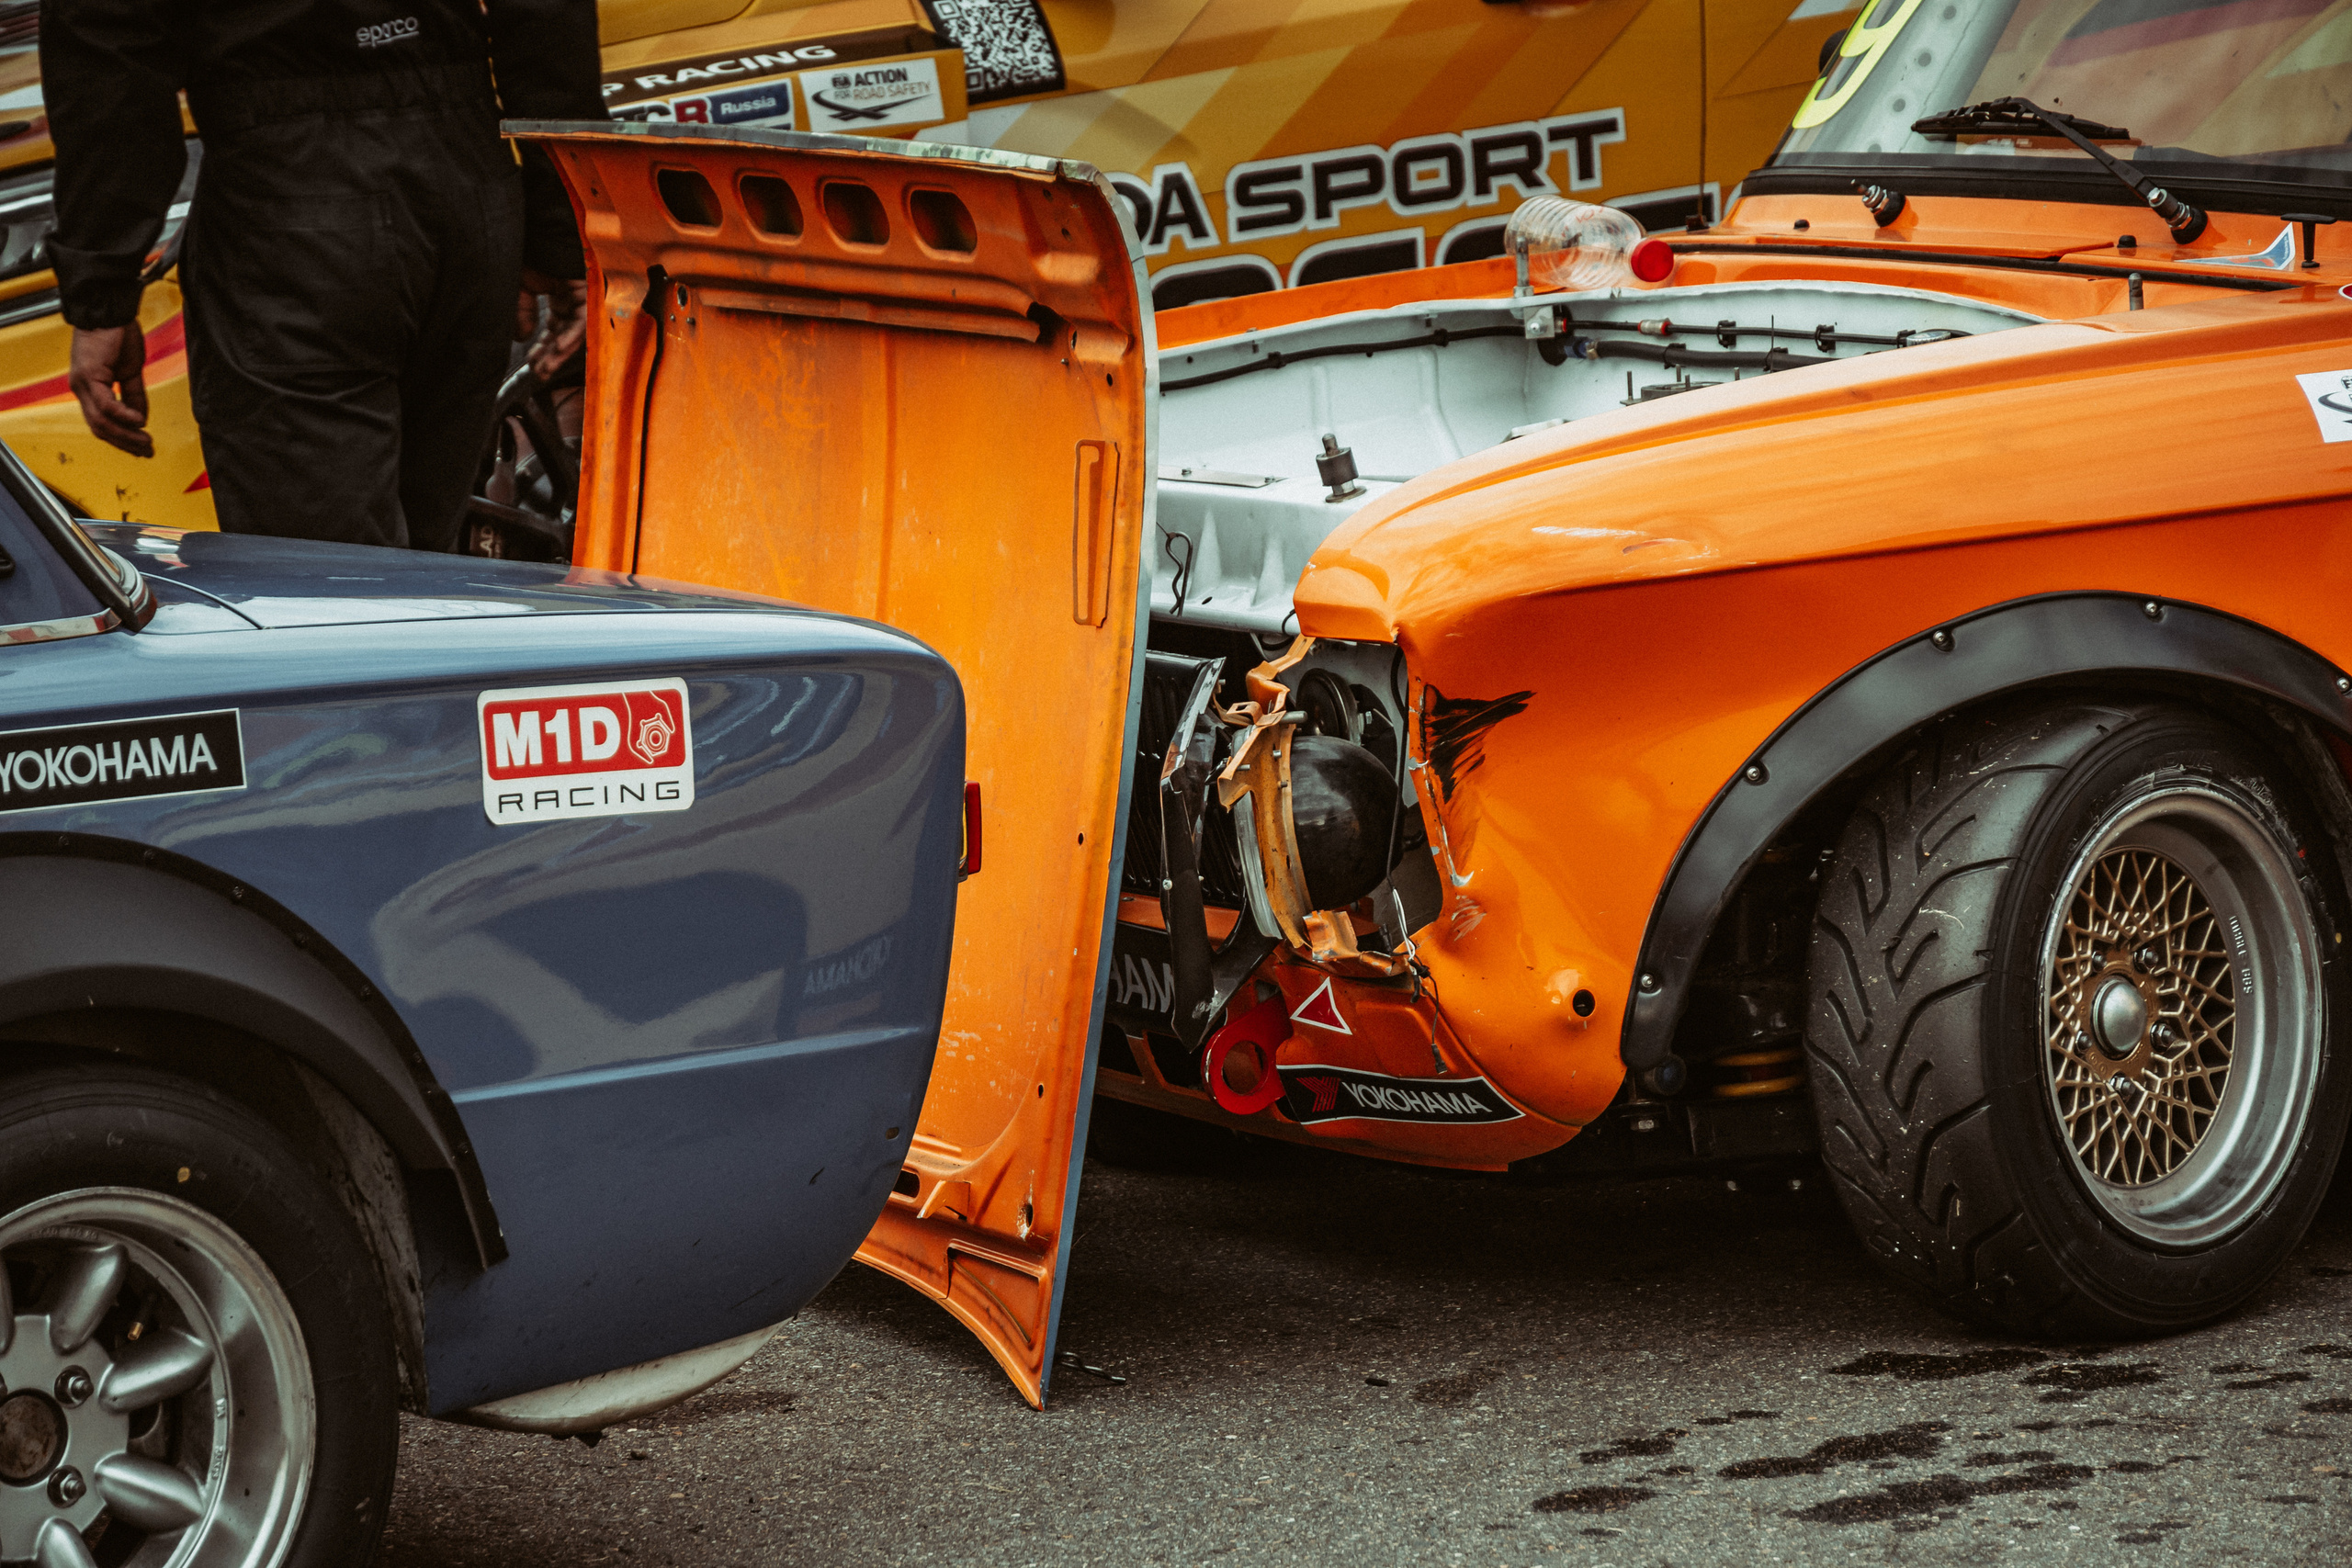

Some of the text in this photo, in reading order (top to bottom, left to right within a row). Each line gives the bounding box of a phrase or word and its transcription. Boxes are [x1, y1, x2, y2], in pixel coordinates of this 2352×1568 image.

[635, 45, 837, 89] RACING
[854, 68, 908, 87] ACTION
[721, 96, 776, 115] Russia
[853, 86, 886, 100] ROAD
[887, 81, 932, 97] SAFETY
[1235, 117, 1619, 232] SPORT
[492, 706, 621, 768] M1D
[0, 733, 218, 793] YOKOHAMA
[499, 781, 680, 814] RACING
[1341, 1082, 1493, 1114] YOKOHAMA
